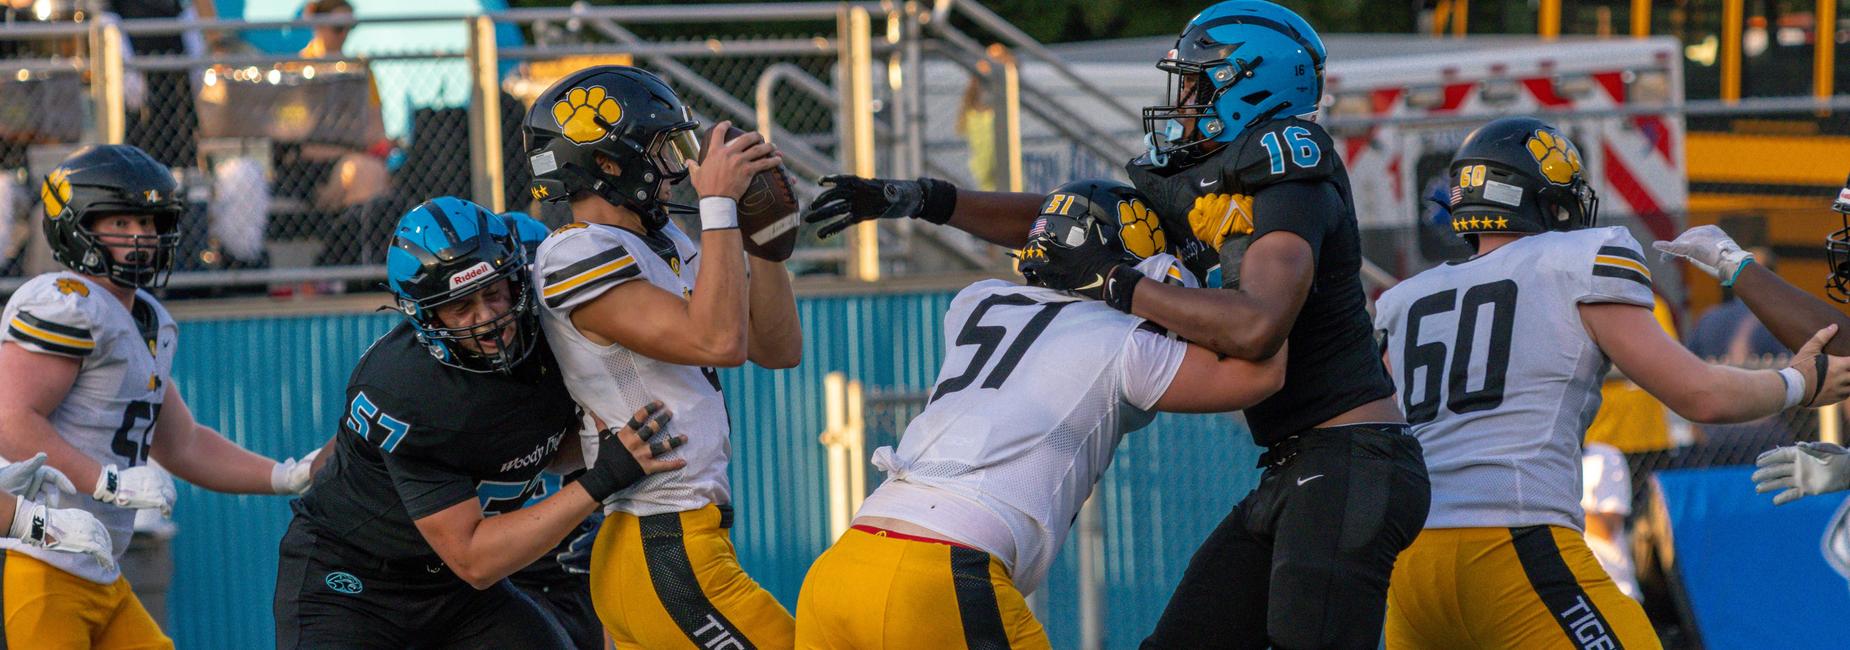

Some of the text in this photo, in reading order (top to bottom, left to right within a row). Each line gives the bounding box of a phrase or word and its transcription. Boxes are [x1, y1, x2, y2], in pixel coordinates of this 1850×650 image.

[1294, 64, 1305, 76] 16
[1260, 126, 1321, 174] 16
[1460, 164, 1487, 188] 60
[1044, 194, 1075, 215] 51
[453, 265, 489, 285] Riddell
[930, 293, 1070, 405] 51
[1403, 279, 1518, 424] 60
[346, 391, 411, 453] 57
